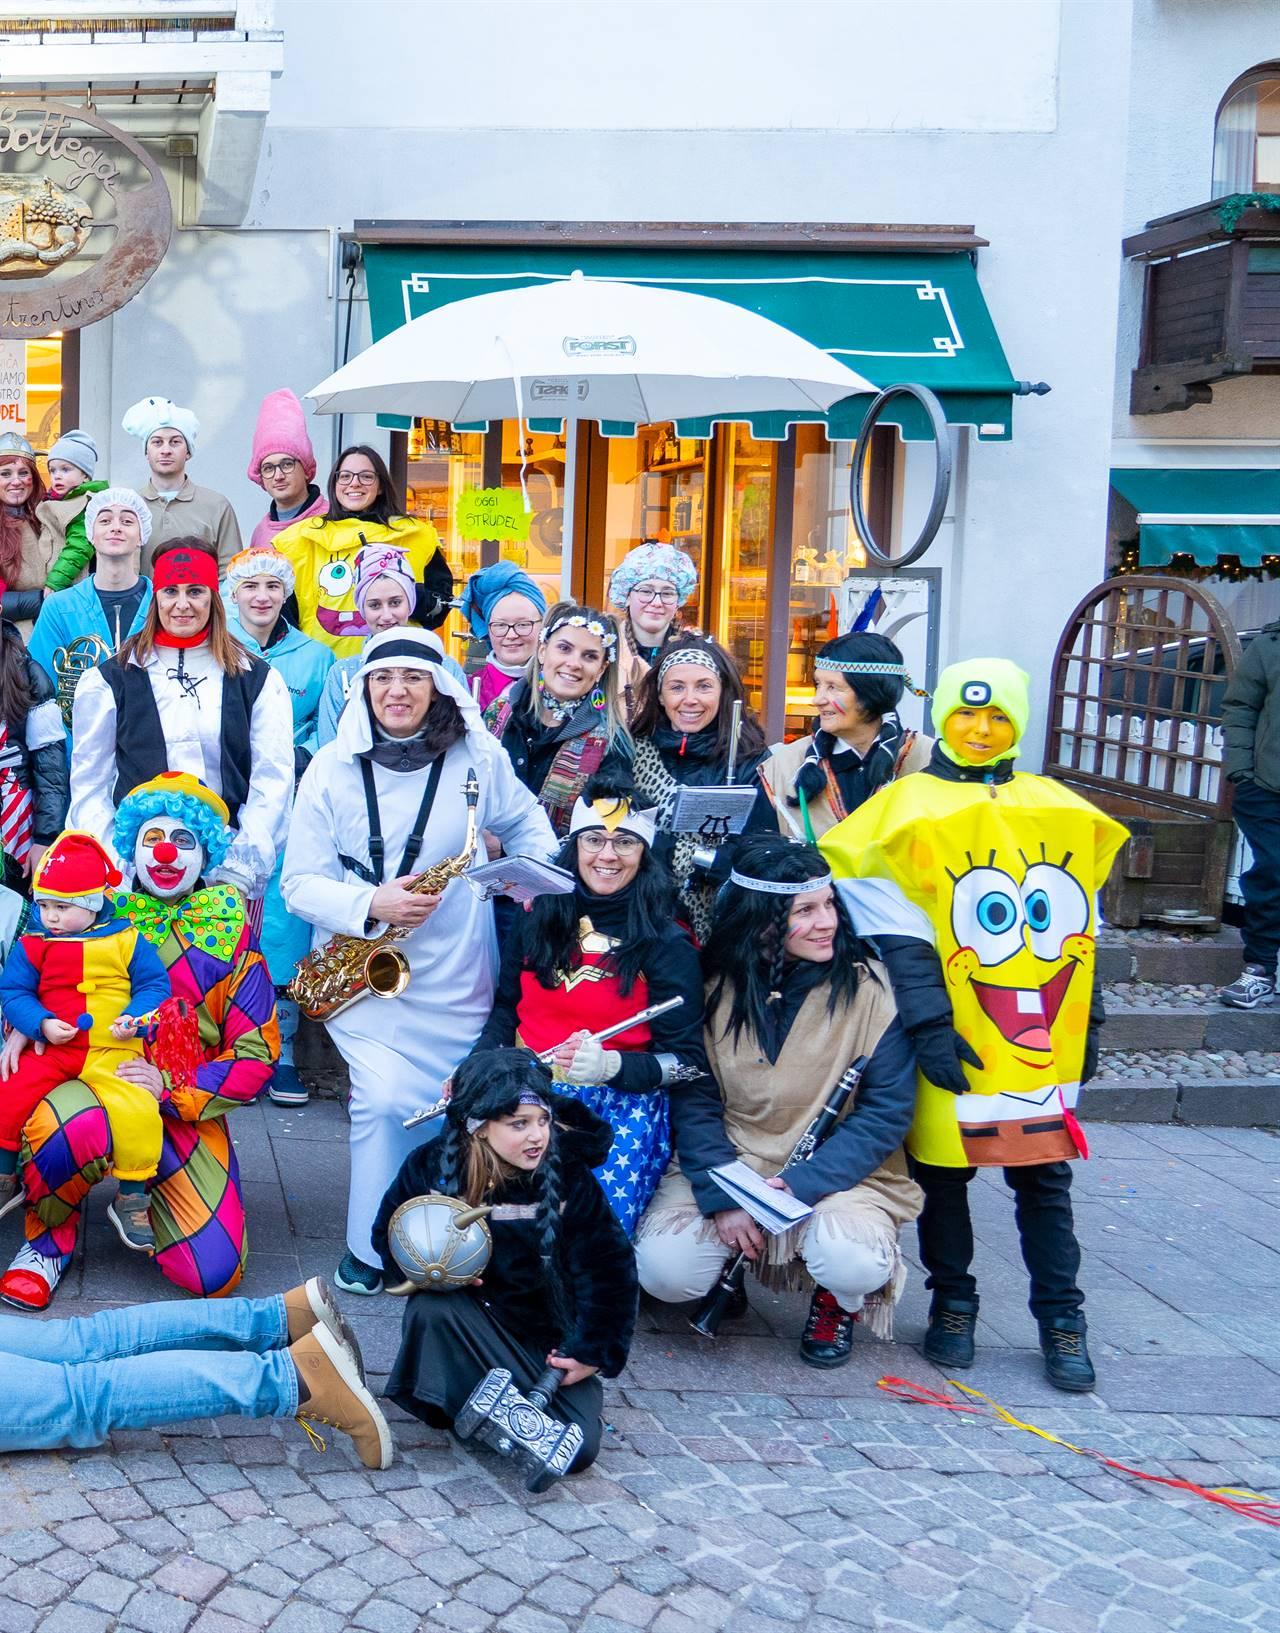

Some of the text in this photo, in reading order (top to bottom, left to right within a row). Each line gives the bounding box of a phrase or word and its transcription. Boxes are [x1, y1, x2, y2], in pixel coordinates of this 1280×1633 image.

[4, 290, 104, 327] trentino
[568, 340, 630, 351] FORST
[475, 496, 498, 507] OGGI
[465, 512, 519, 531] STRUDEL
